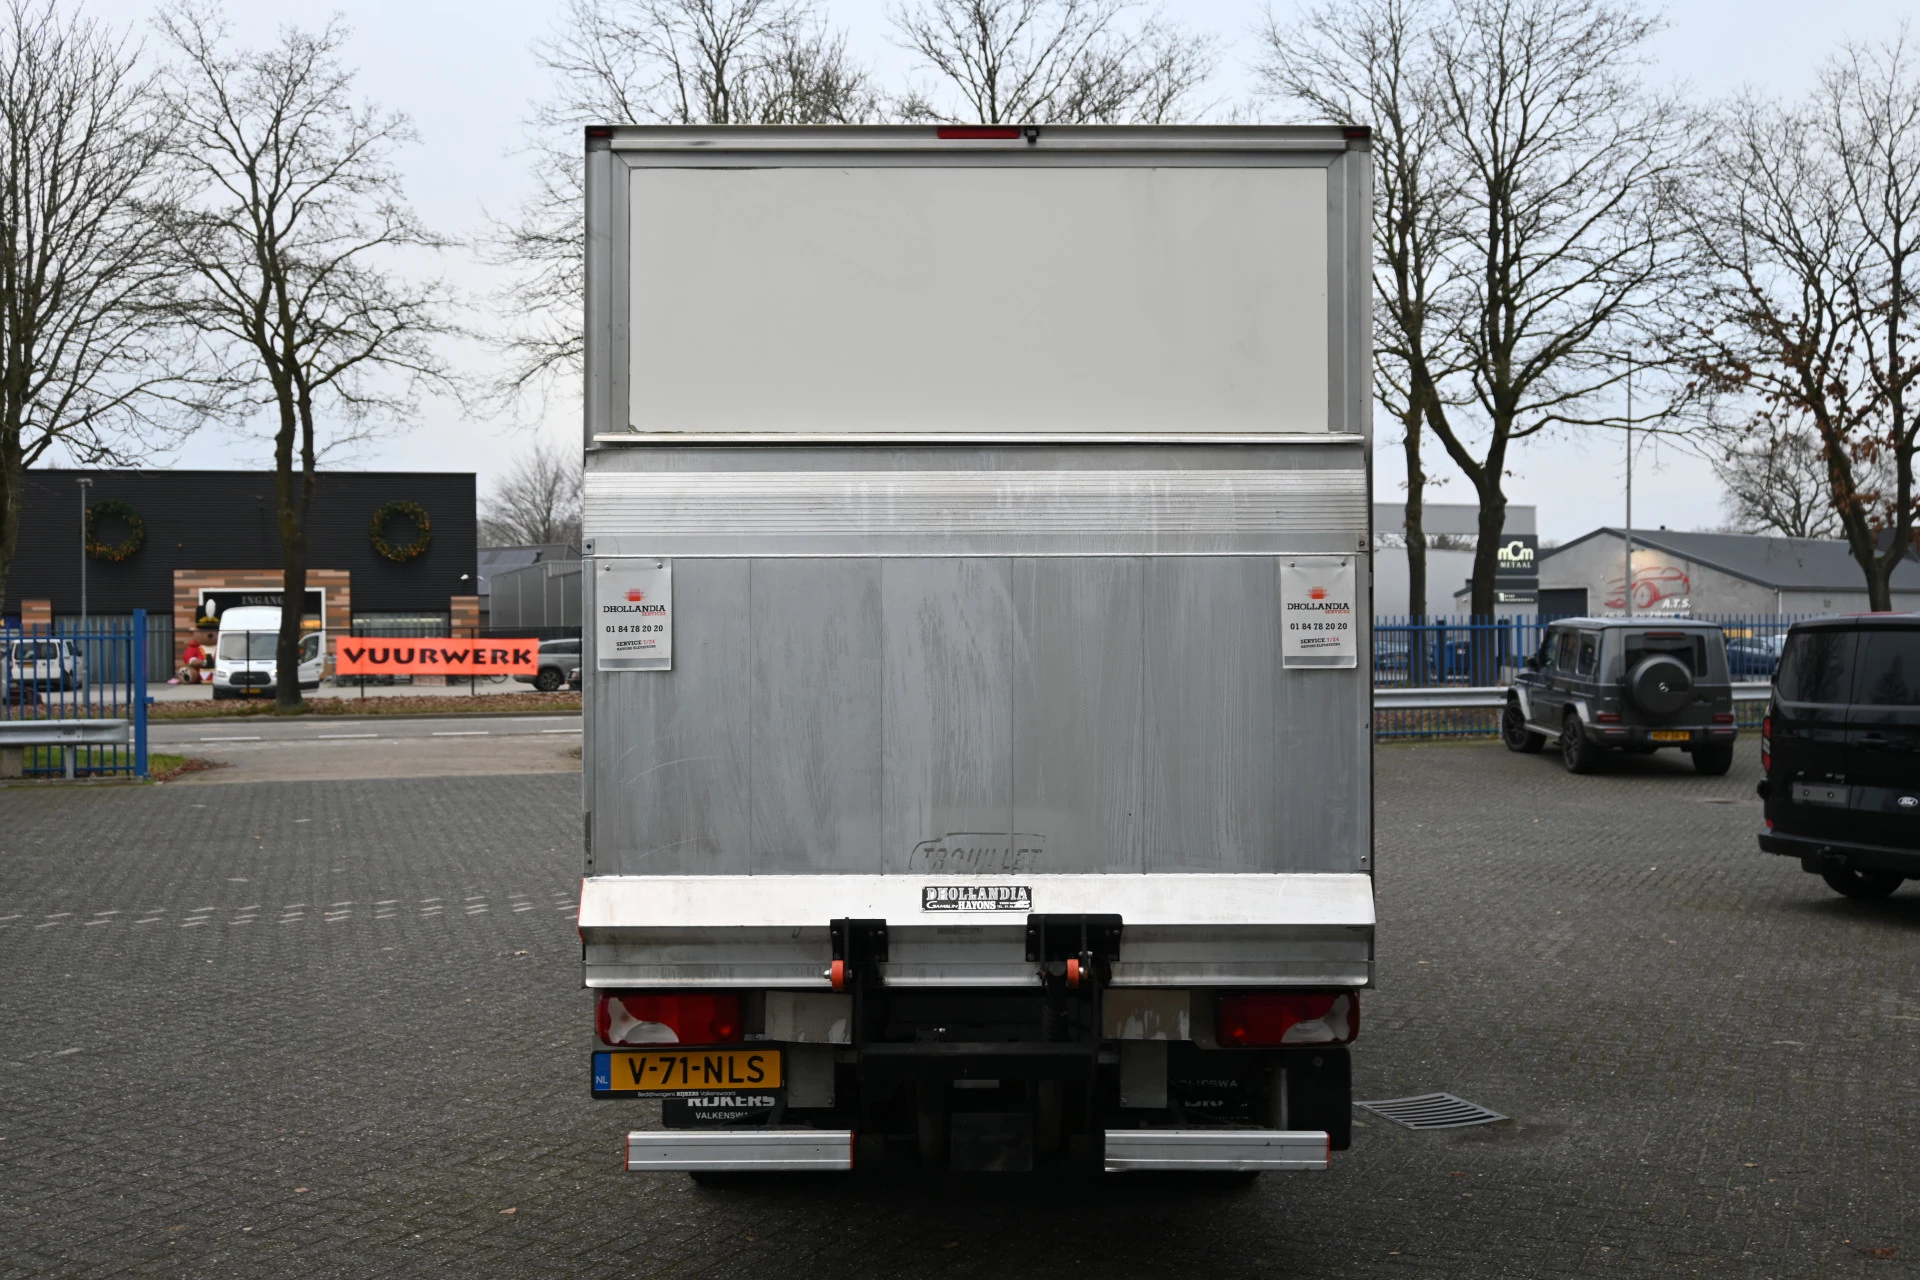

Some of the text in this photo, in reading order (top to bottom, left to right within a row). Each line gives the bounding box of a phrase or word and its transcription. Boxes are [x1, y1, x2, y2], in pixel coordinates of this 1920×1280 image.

[1287, 602, 1350, 610] DHOLLANDIA
[1662, 598, 1691, 609] A.T.S.
[603, 604, 666, 613] DHOLLANDIA
[618, 625, 628, 633] 84
[630, 625, 640, 633] 78
[653, 624, 664, 632] 20
[1325, 622, 1335, 630] 20
[1337, 622, 1348, 630] 20
[343, 647, 532, 665] VUURWERK
[926, 887, 1028, 901] DHOLLANDIA
[958, 900, 997, 910] HAYONS
[628, 1056, 765, 1085] V-71-NLS
[595, 1075, 608, 1084] NL
